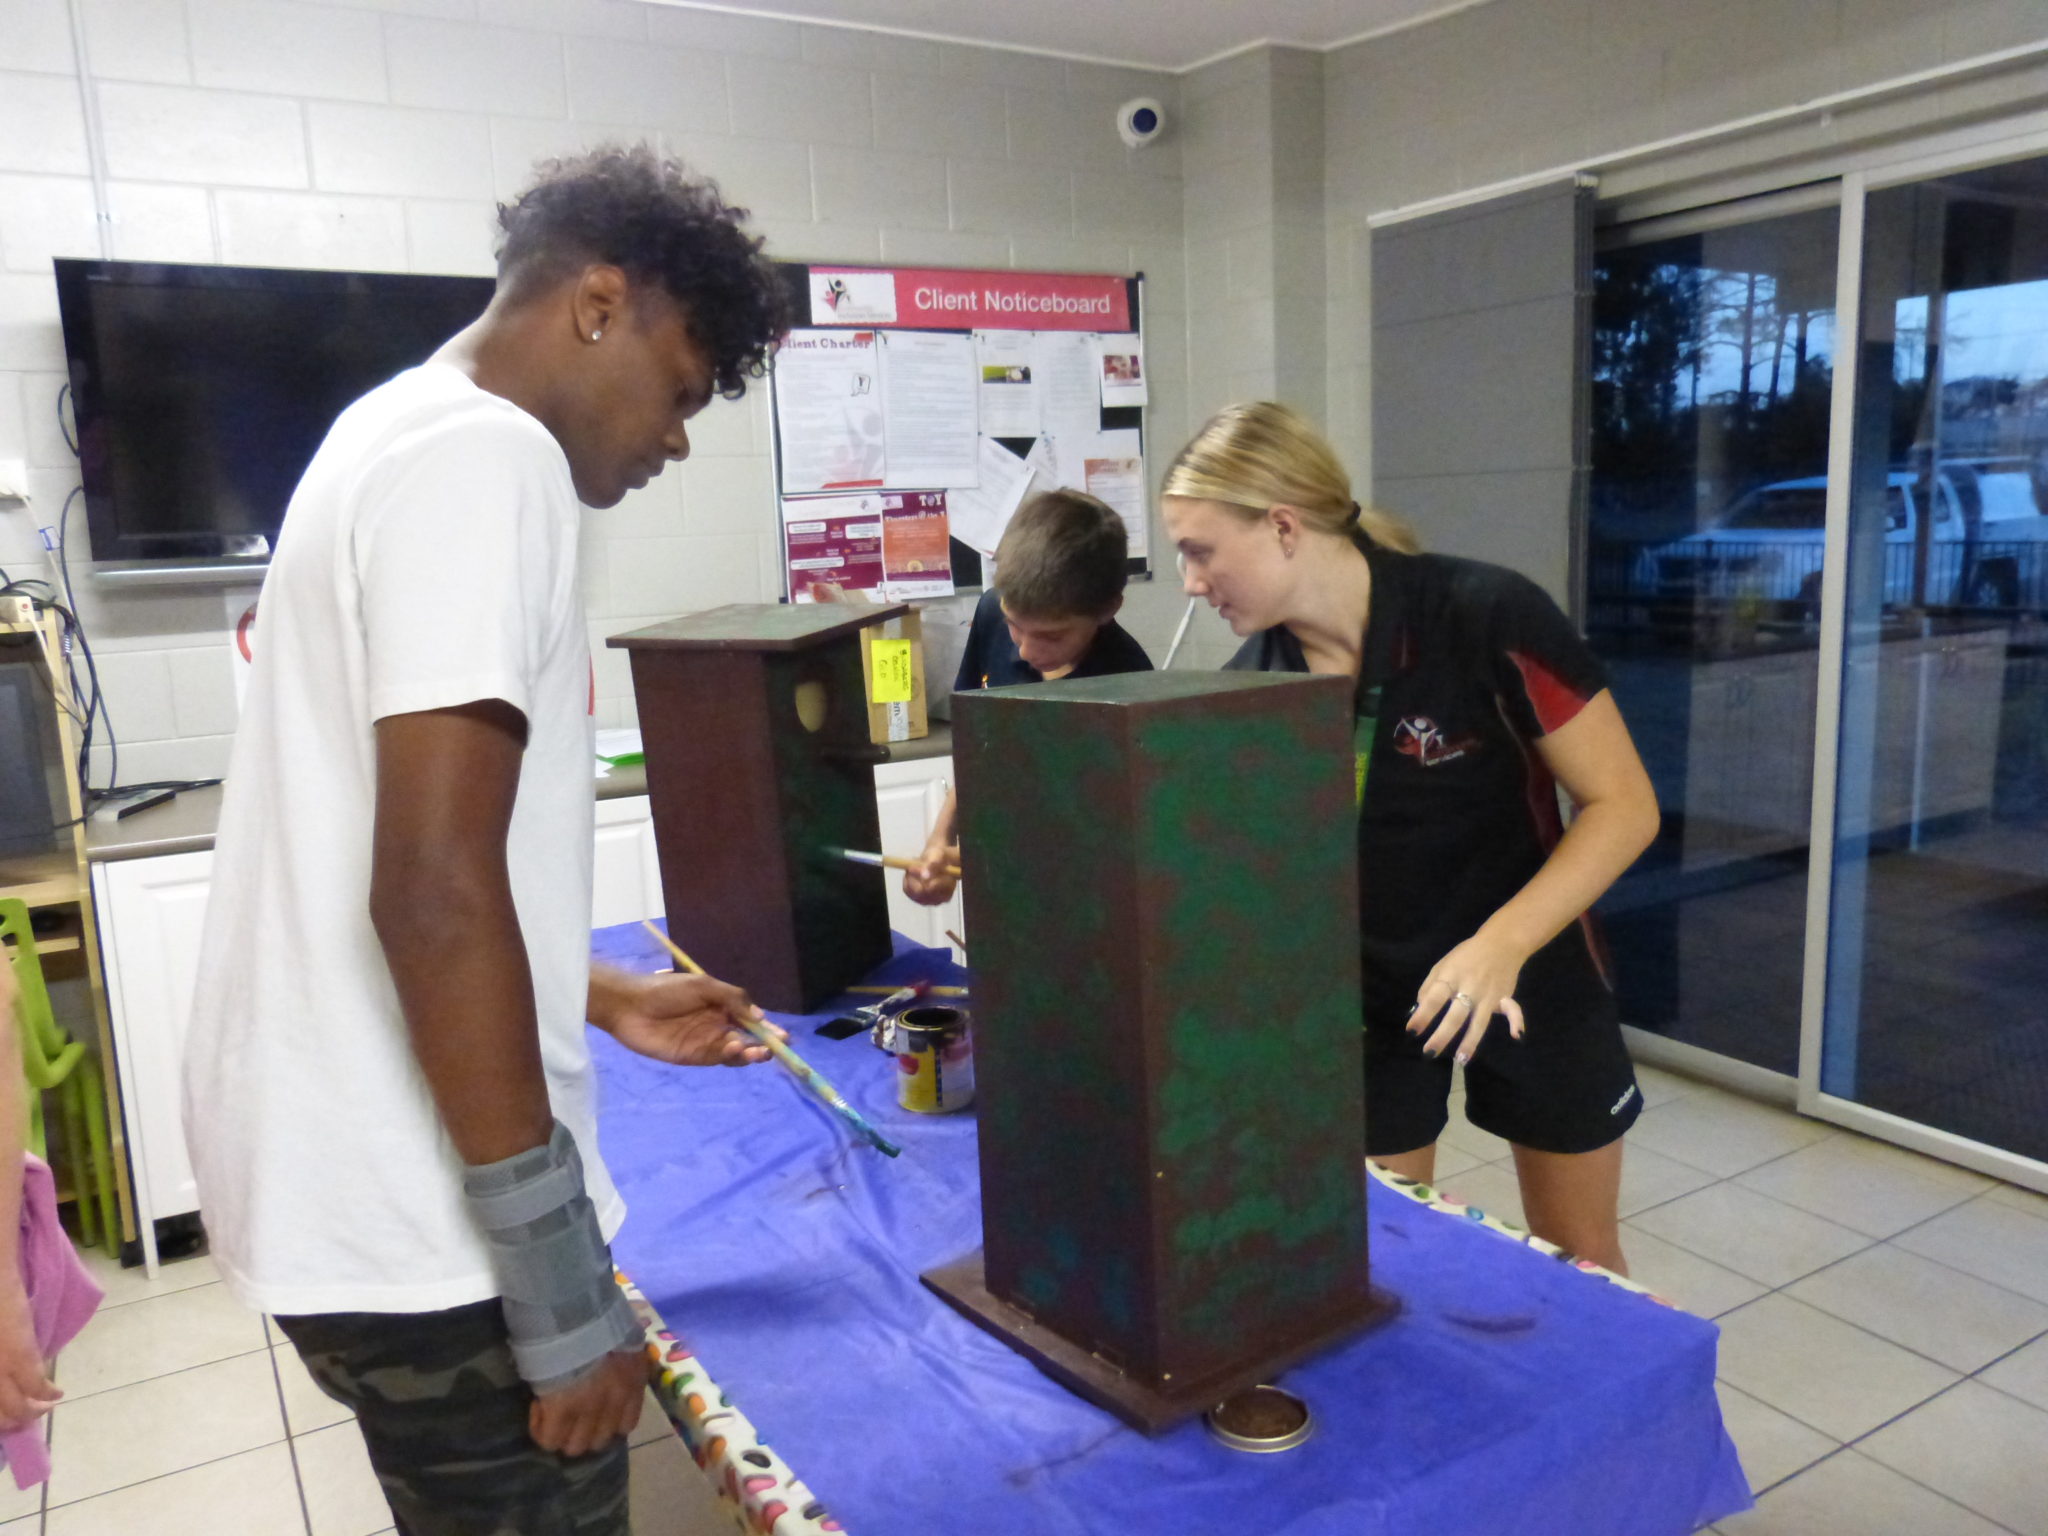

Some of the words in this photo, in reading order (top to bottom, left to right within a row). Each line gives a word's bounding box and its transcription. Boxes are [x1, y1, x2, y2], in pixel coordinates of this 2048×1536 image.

[915, 287, 978, 311] Client
[984, 290, 1111, 314] Noticeboard
[820, 338, 871, 349] Charter
